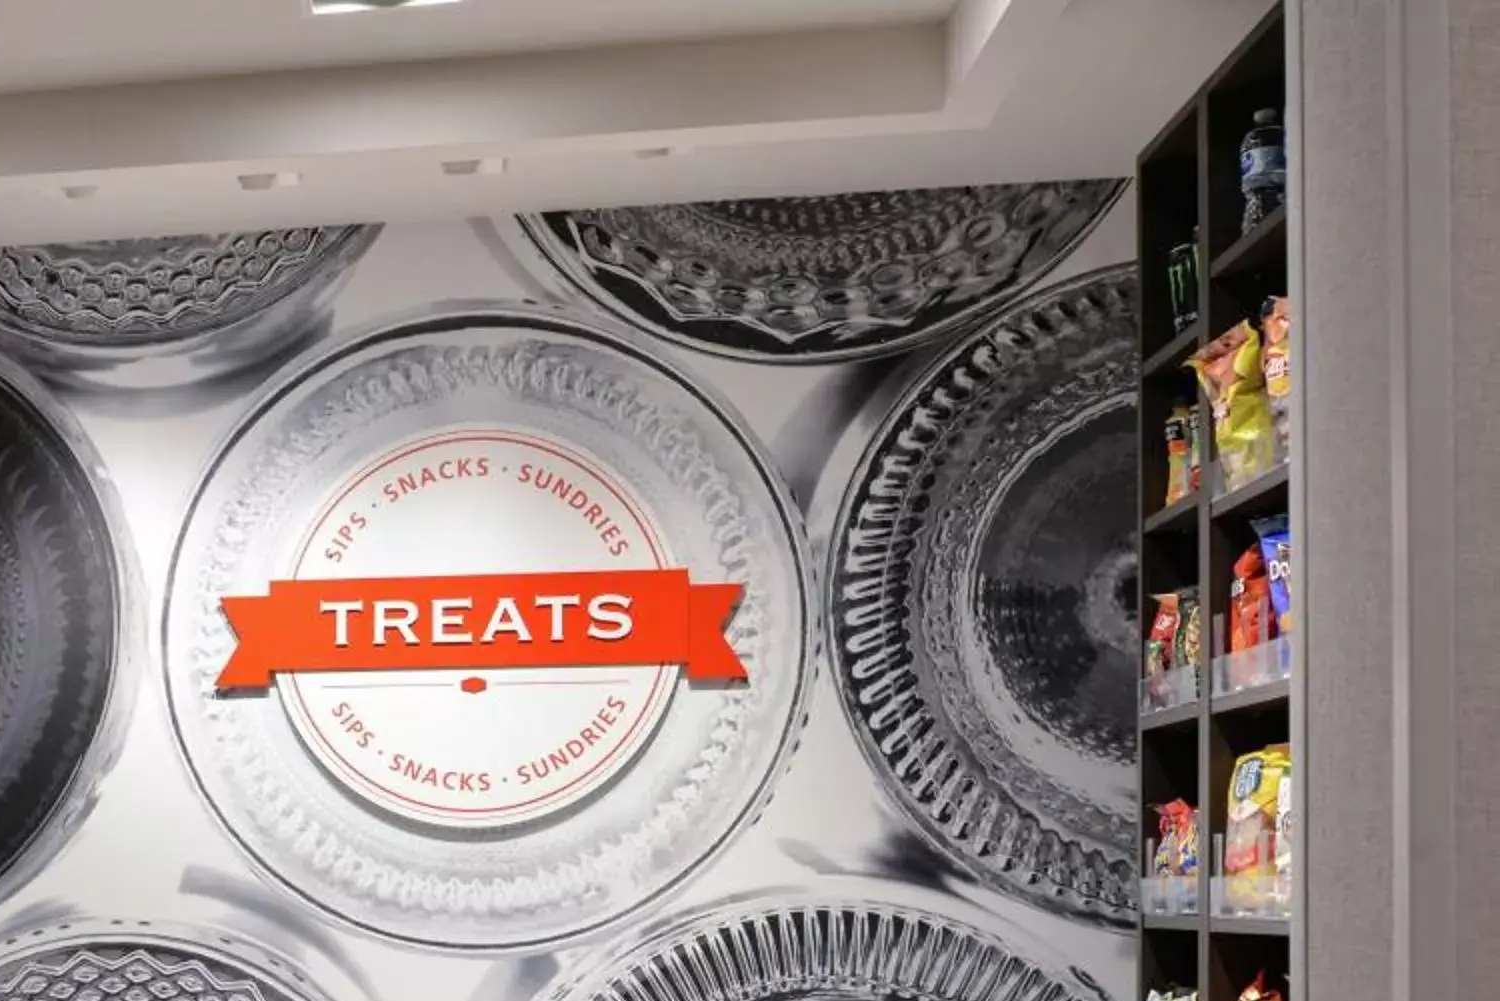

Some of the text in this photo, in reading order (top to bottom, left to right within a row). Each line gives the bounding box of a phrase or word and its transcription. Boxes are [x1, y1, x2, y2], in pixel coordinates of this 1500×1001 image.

[325, 457, 629, 562] SIPS SNACKS SUNDRIES
[320, 594, 633, 646] TREATS
[332, 695, 627, 792] SIPS SNACKS SUNDRIES
